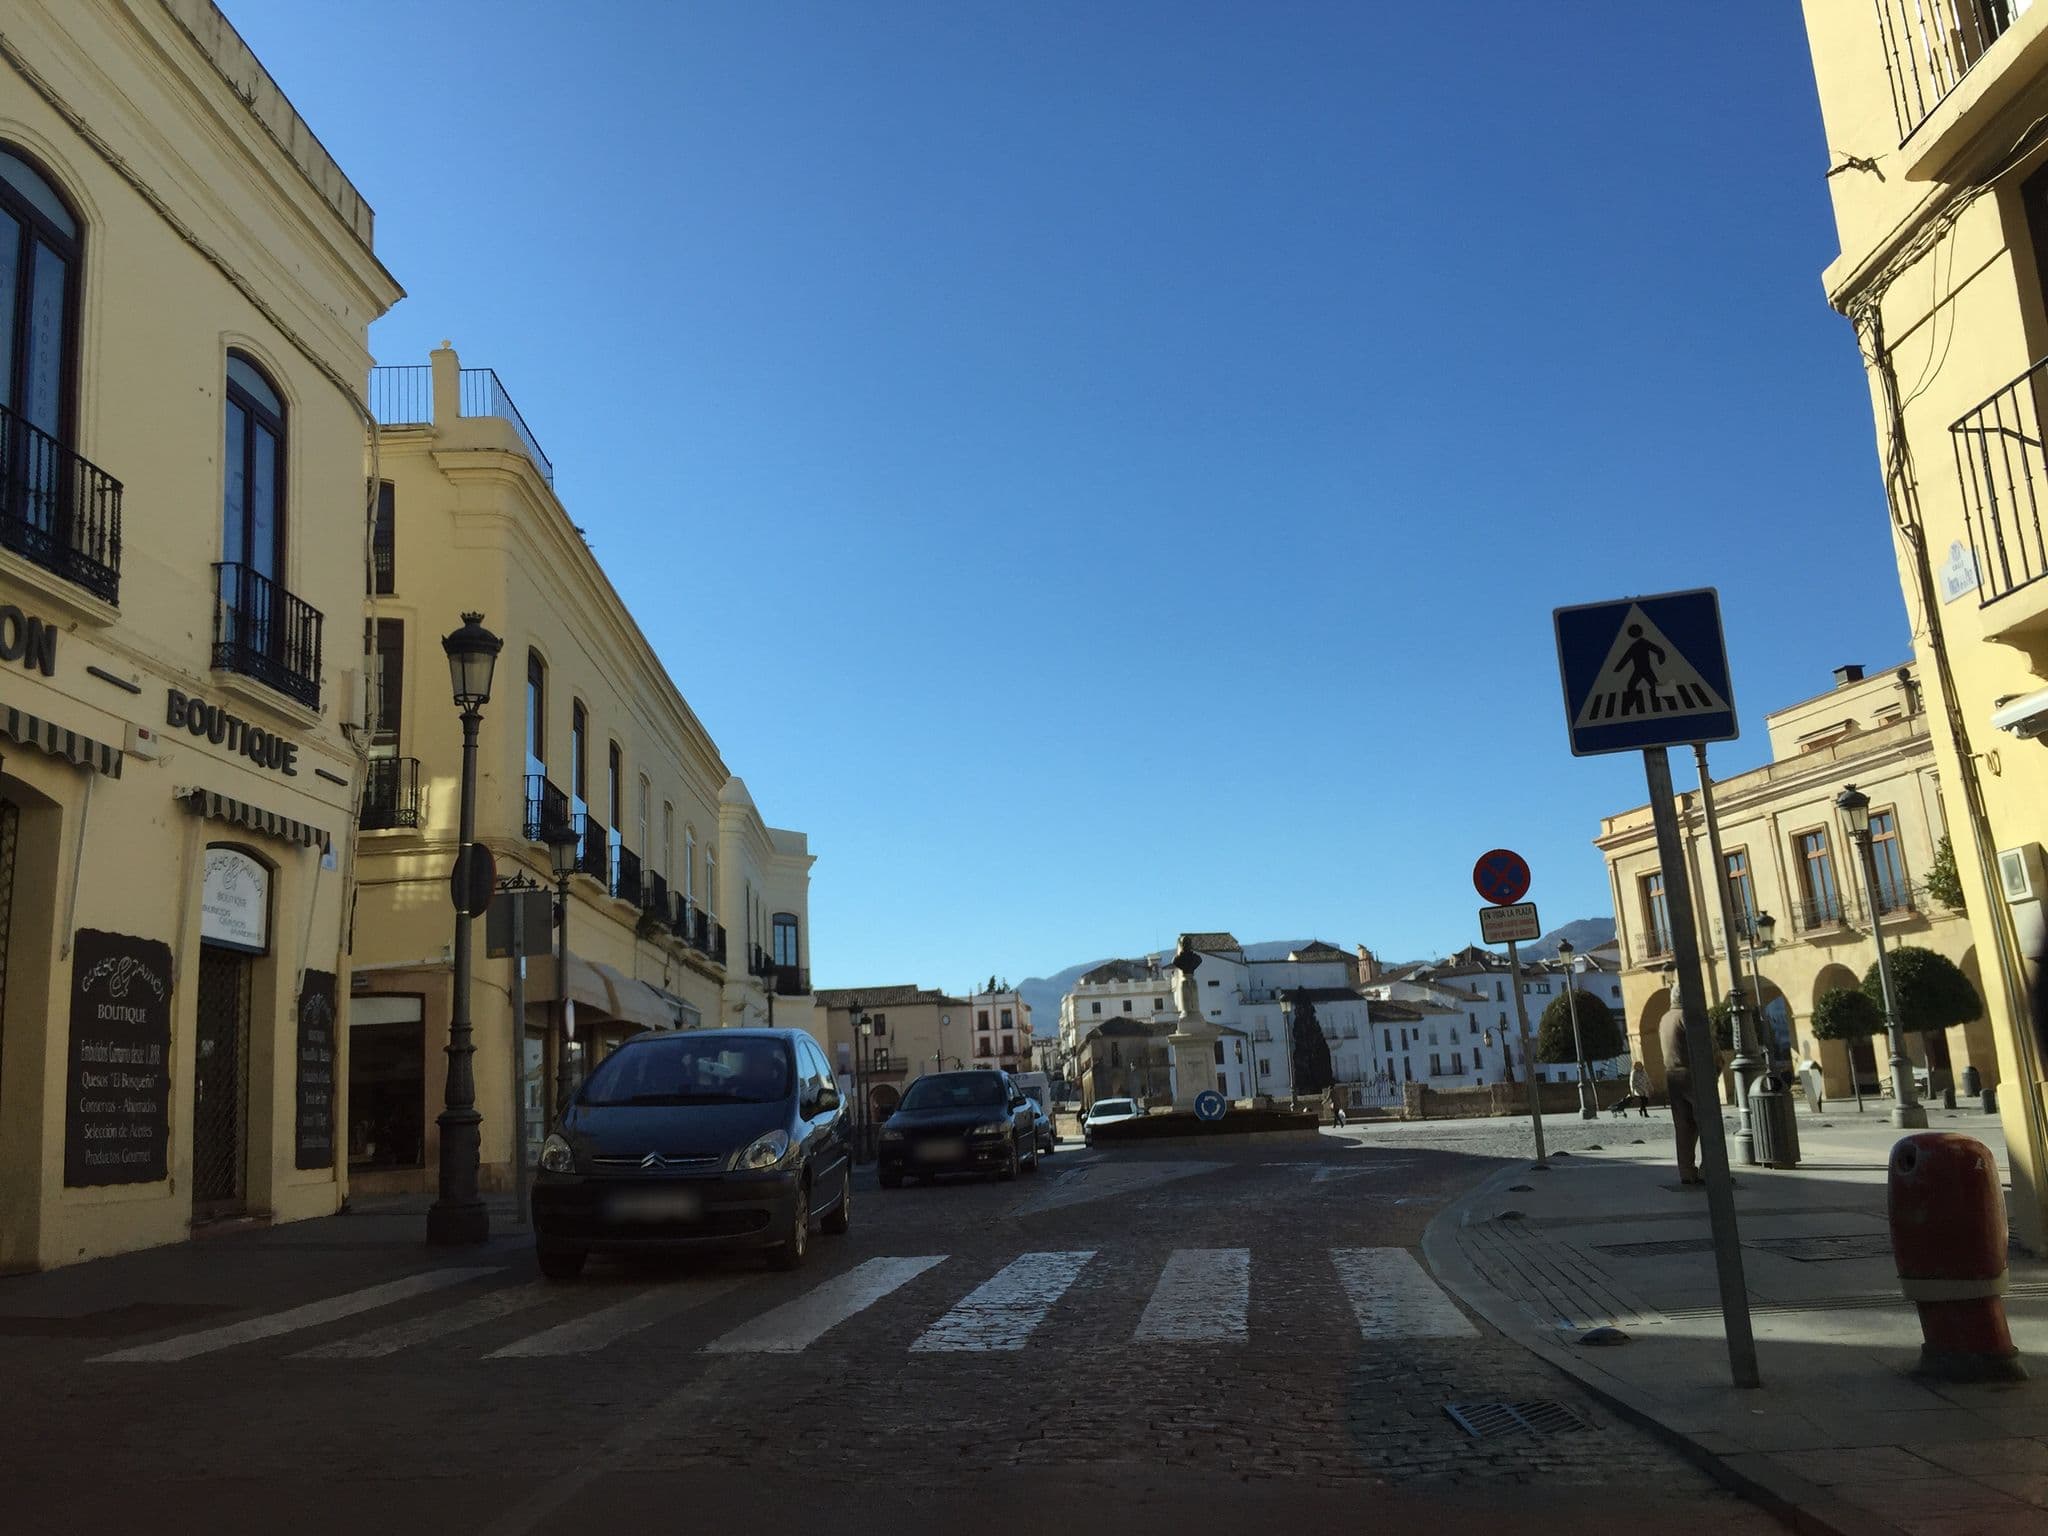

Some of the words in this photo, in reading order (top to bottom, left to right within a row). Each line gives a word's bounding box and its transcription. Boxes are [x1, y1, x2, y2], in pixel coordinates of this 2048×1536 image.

[167, 688, 298, 777] BOUTIQUE
[97, 1004, 147, 1025] BOUTIQUE
[82, 1071, 109, 1090] Quesos
[84, 1122, 117, 1139] Selección
[118, 1121, 127, 1138] de
